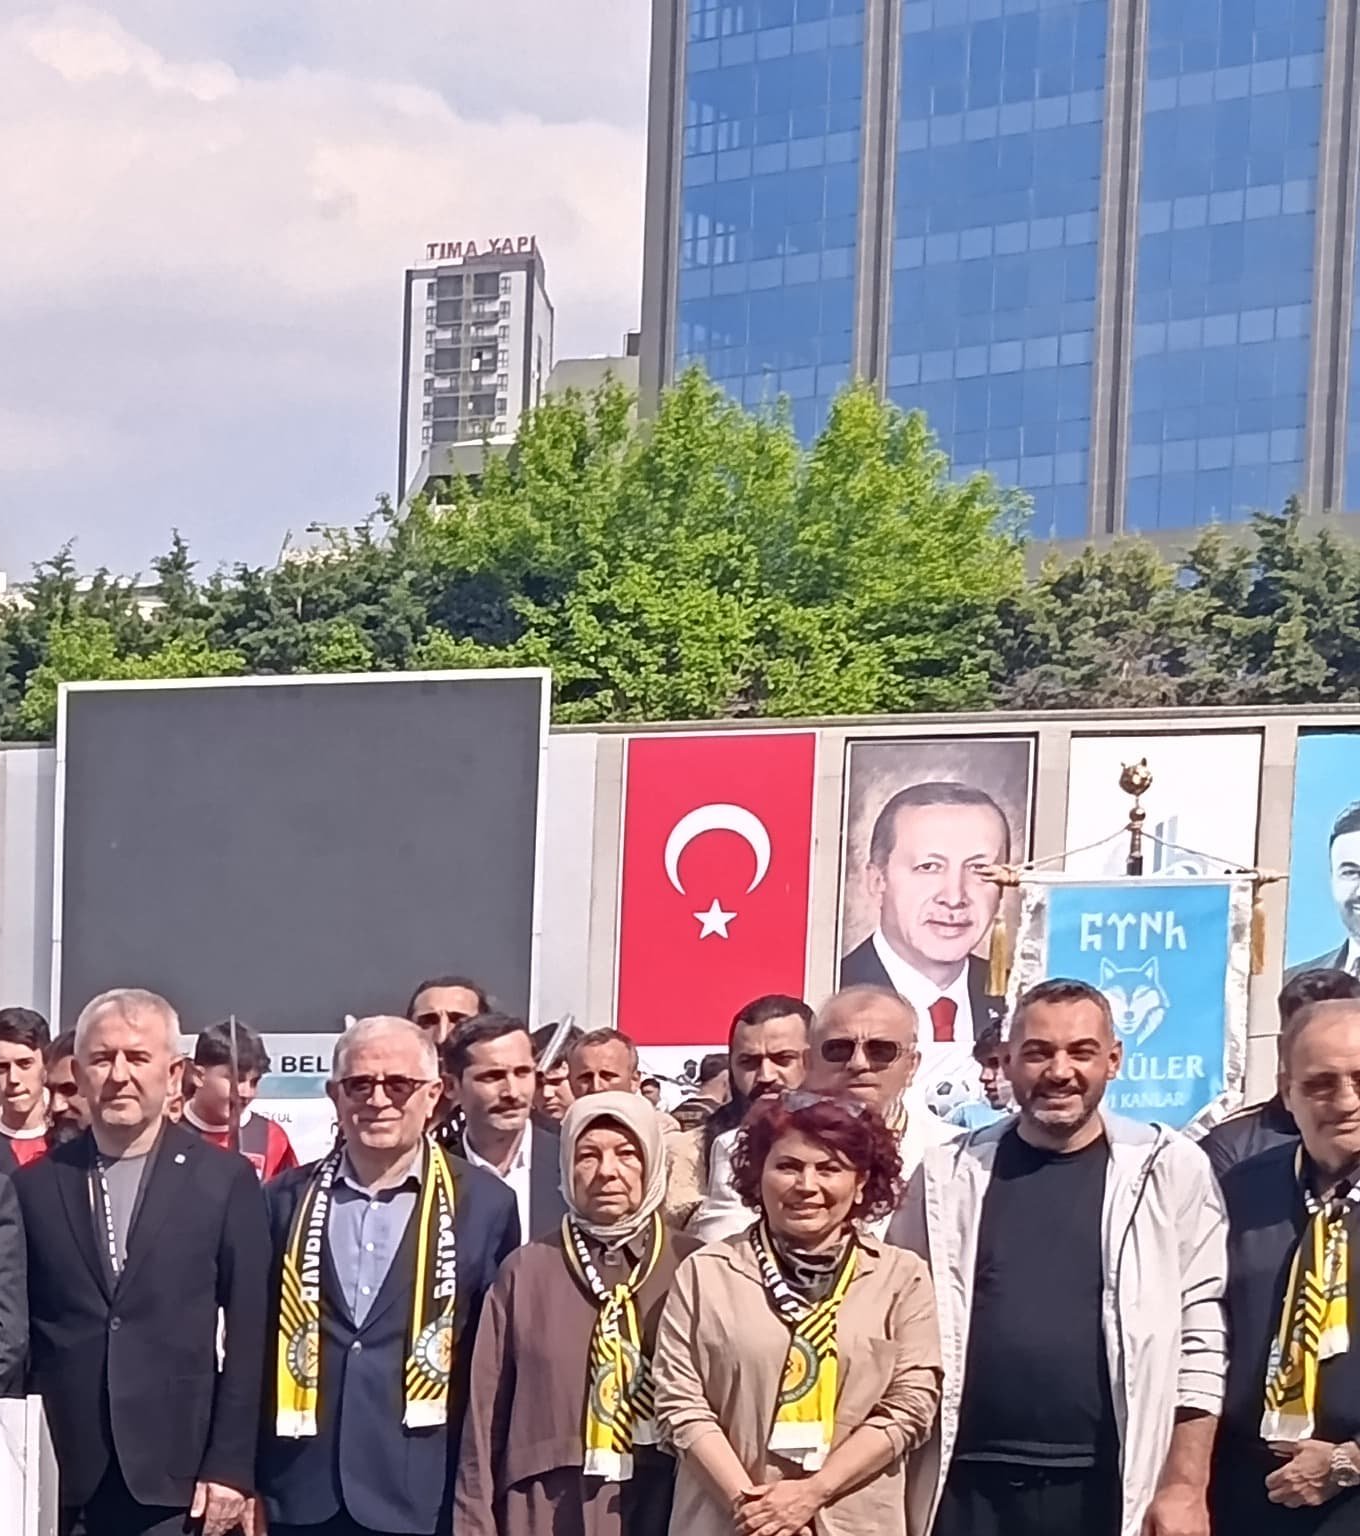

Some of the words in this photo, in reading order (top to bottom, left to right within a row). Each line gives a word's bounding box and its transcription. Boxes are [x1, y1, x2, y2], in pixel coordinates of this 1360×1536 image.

[426, 240, 478, 260] TIMA
[488, 235, 536, 257] YAPI
[281, 1055, 331, 1073] BEL
